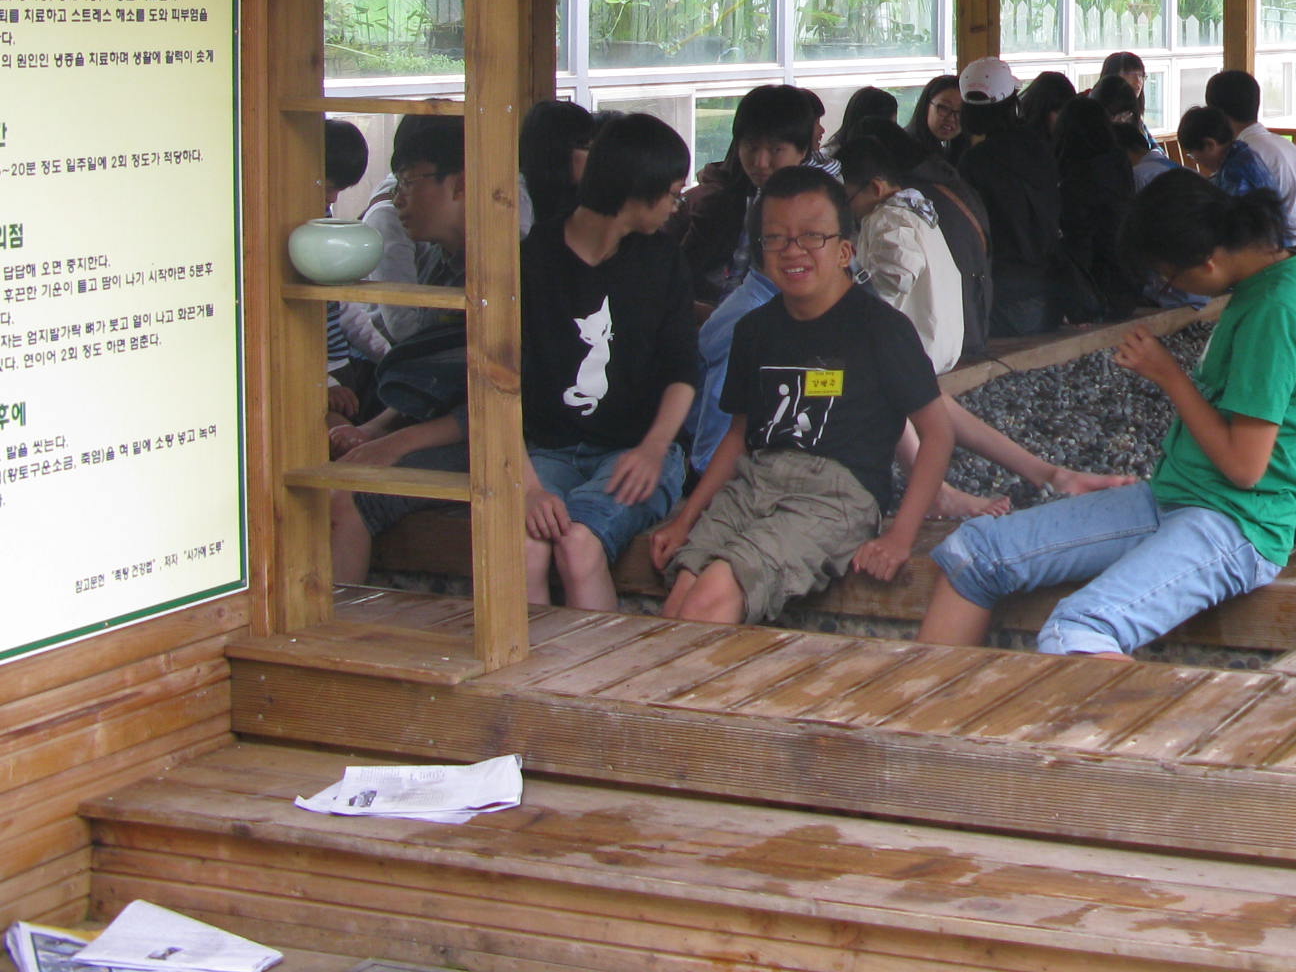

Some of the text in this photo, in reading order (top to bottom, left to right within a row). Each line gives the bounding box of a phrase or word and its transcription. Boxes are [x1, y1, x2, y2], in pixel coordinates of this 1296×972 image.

[24, 8, 67, 23] 치료하고
[71, 8, 112, 23] 스트레스
[116, 8, 145, 23] 해소를
[149, 8, 168, 22] 도와
[171, 7, 208, 22] 피부염을
[0, 31, 16, 46] 다.
[17, 52, 49, 69] 원인인
[53, 52, 85, 68] 냉증을
[89, 50, 129, 66] 치료하며
[132, 50, 161, 66] 생활에
[165, 49, 193, 64] 활력이
[0, 149, 204, 177] ~20분 정도 일주일에 2회 정도가 적당하다.
[3, 254, 111, 281] 답답해 오면 중지한다.
[4, 286, 37, 303] 후끈한
[41, 281, 73, 299] 기운이
[77, 278, 97, 294] 들고
[102, 275, 121, 290] 땀이
[125, 271, 145, 286] 나기
[148, 266, 186, 284] 시작하면
[27, 324, 81, 346] 엄지발가락
[110, 316, 128, 332] 붓고
[155, 309, 174, 324] 나고
[24, 350, 56, 369] 연이어
[61, 347, 78, 362] 2회
[83, 343, 102, 360] 정도
[107, 339, 126, 354] 하면
[130, 333, 162, 351] 멈춘다.
[6, 435, 69, 460] 발을 씻는다.
